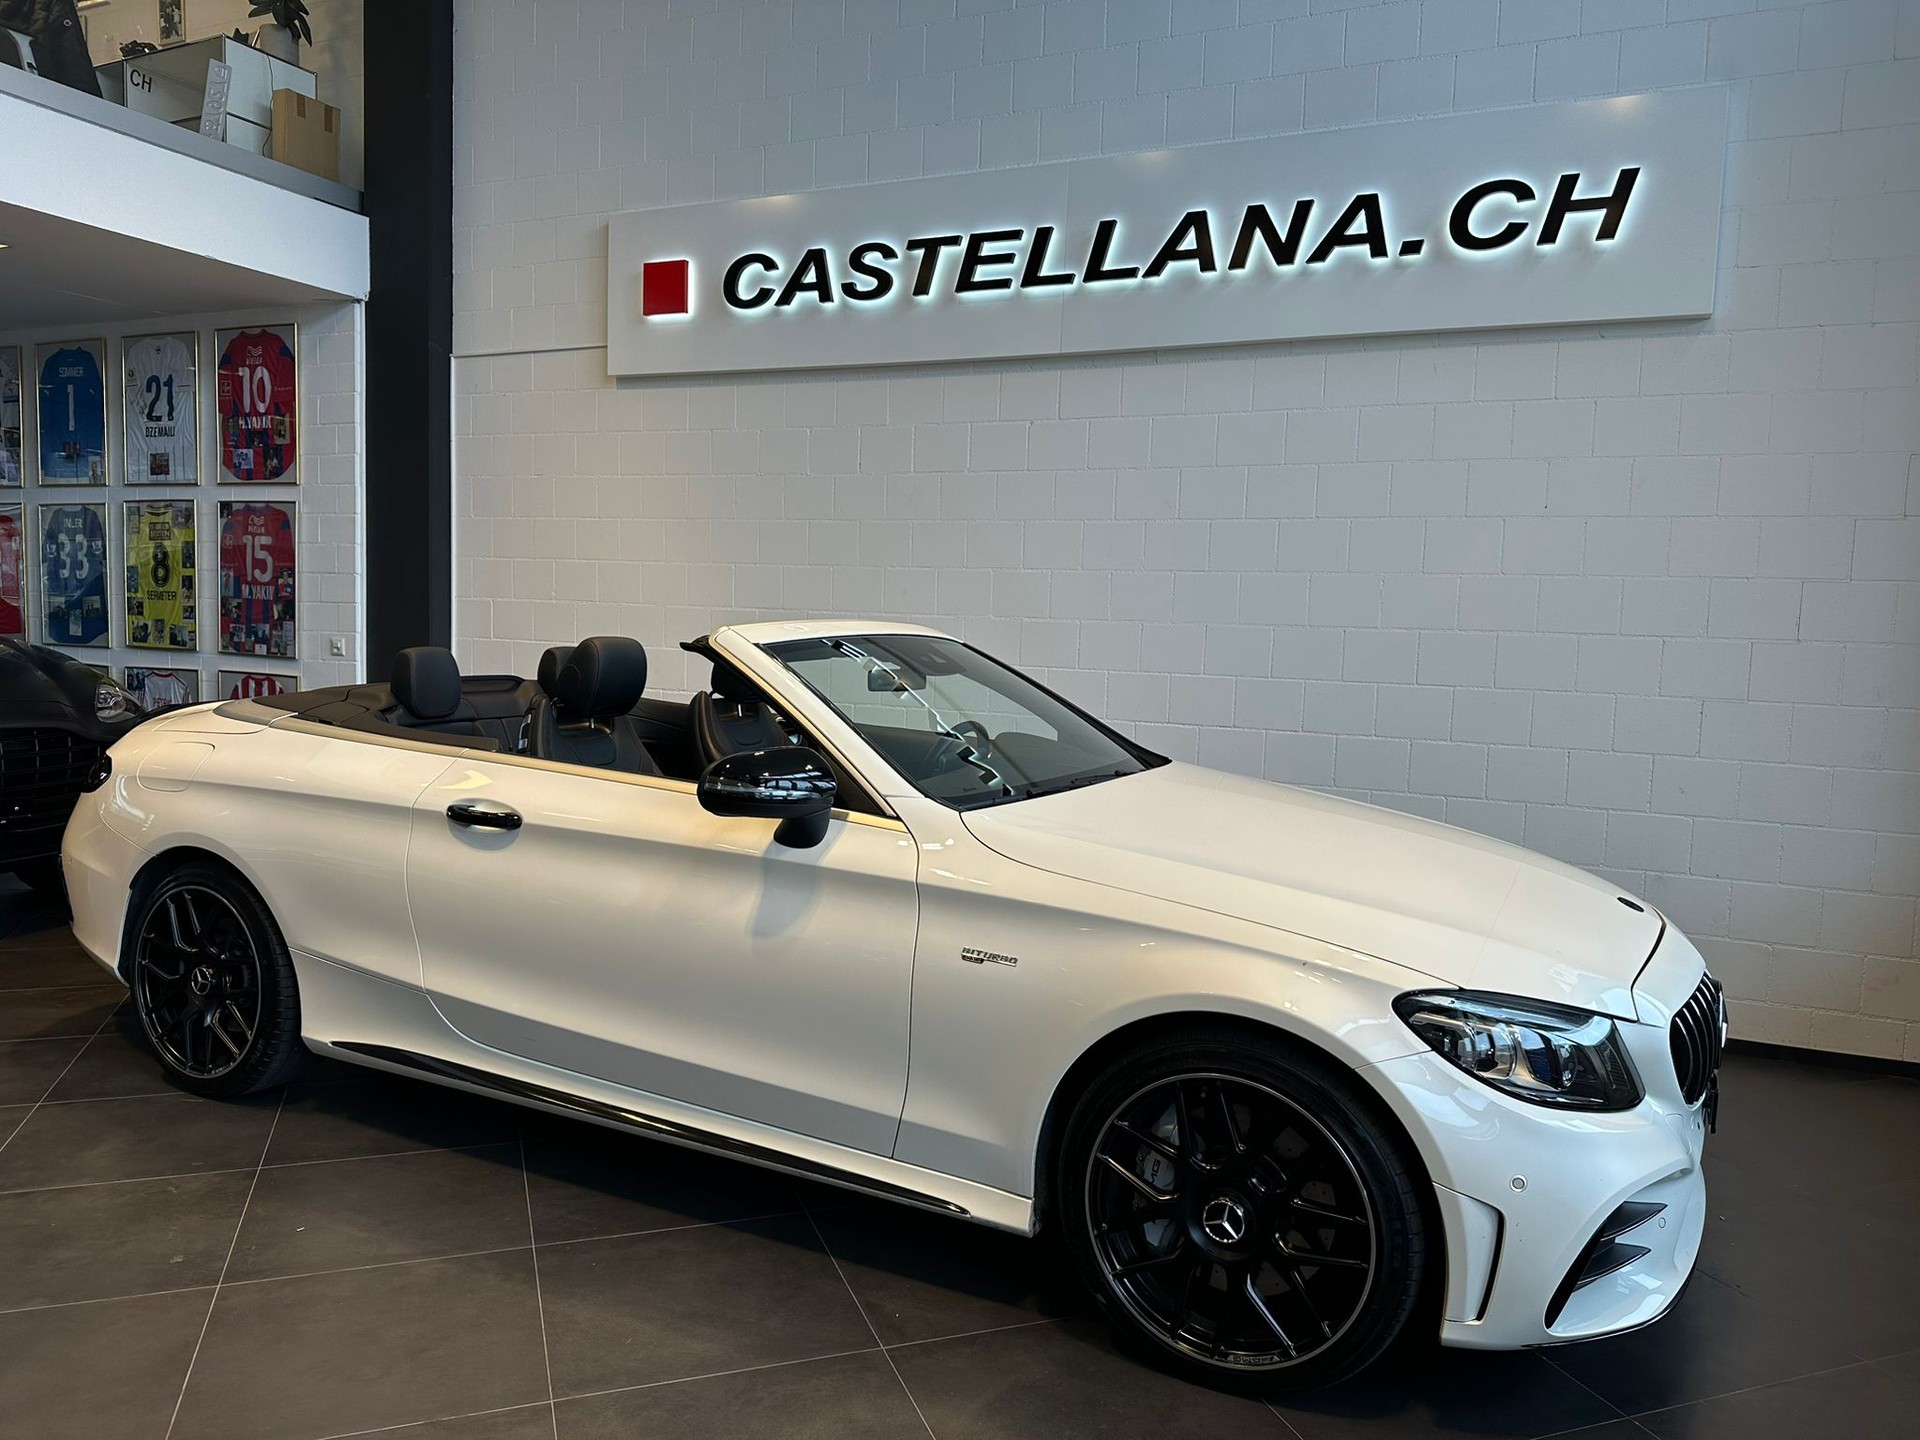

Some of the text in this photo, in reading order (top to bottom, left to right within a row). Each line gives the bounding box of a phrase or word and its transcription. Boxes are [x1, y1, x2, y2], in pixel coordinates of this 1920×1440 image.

[130, 69, 152, 93] CH
[722, 166, 1641, 311] CASTELLANA.CH
[67, 384, 75, 431] 1
[146, 373, 174, 422] 21
[239, 366, 272, 413] 10
[58, 532, 89, 580] 33
[151, 541, 171, 588] 8
[242, 534, 274, 583] 15
[961, 946, 1019, 964] BITURBO
